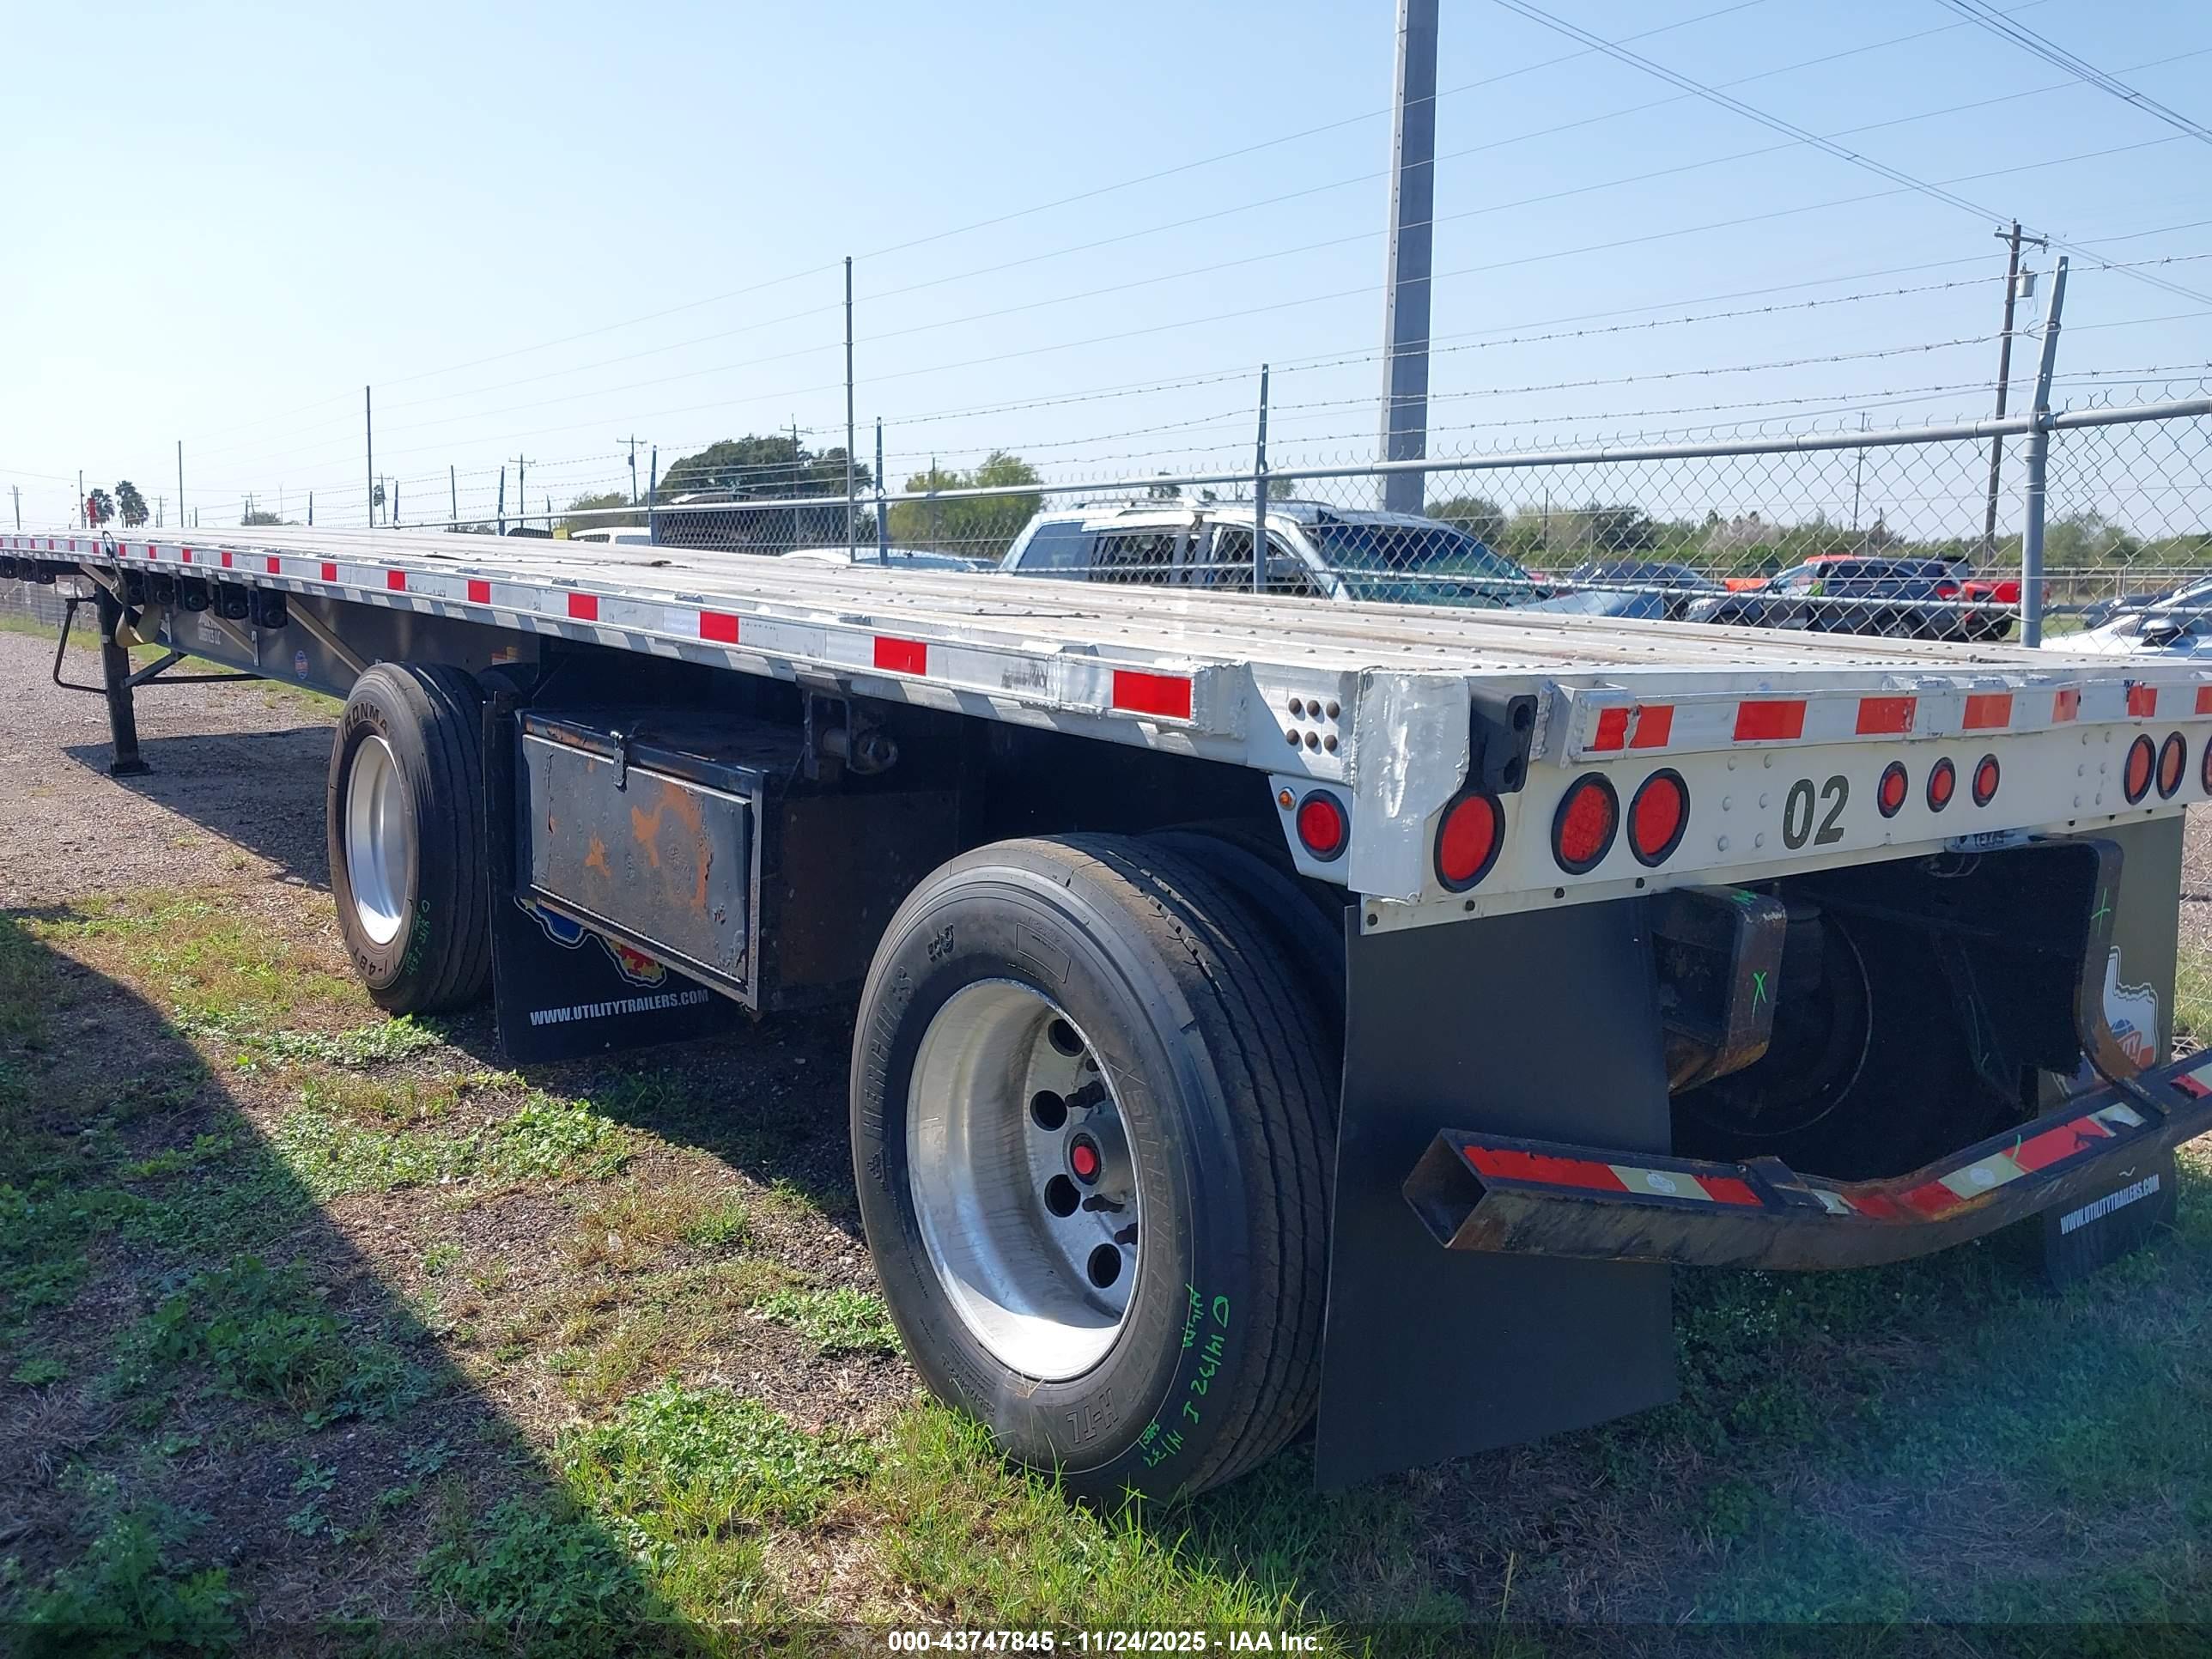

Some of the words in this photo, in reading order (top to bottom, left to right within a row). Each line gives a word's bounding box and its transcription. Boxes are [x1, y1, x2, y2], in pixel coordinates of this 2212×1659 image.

[1783, 775, 1849, 849] 02
[530, 989, 709, 1026] WWW.UTILITYTRAILERS.COM
[2061, 1174, 2160, 1235] WWW.UTILITYTRAILERS.COM
